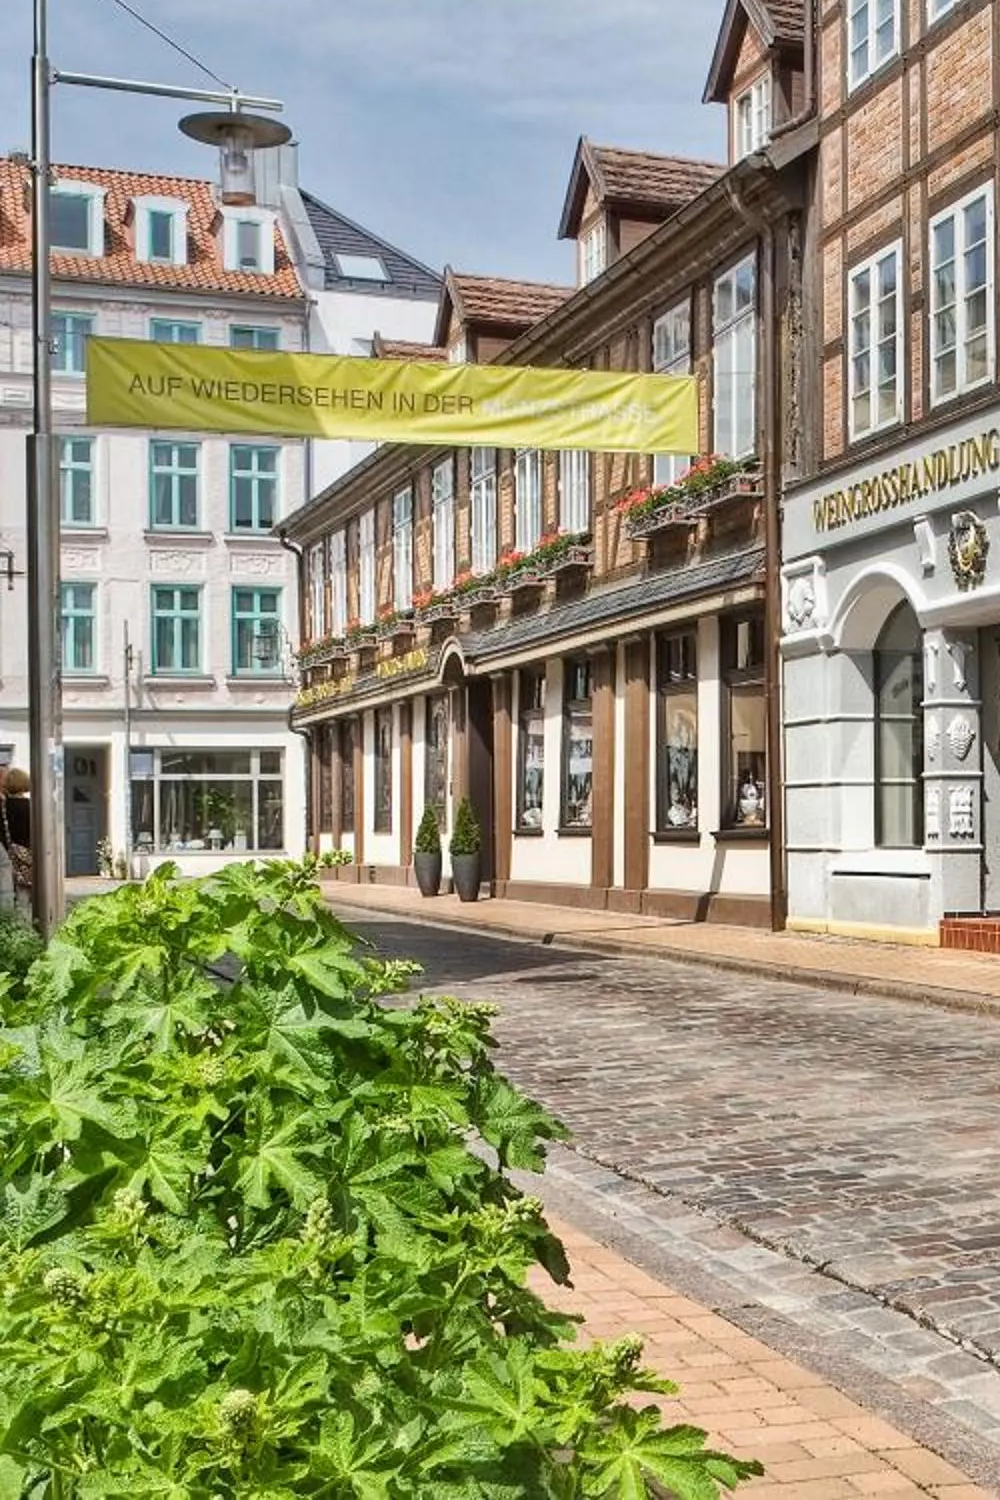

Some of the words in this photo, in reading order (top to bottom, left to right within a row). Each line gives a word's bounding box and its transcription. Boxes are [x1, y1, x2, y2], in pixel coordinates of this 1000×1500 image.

[128, 373, 183, 397] AUF
[191, 379, 383, 410] WIEDERSEHEN
[393, 392, 415, 413] IN
[424, 393, 474, 415] DER
[812, 428, 1000, 532] WEINGROSSHANDLUNG
